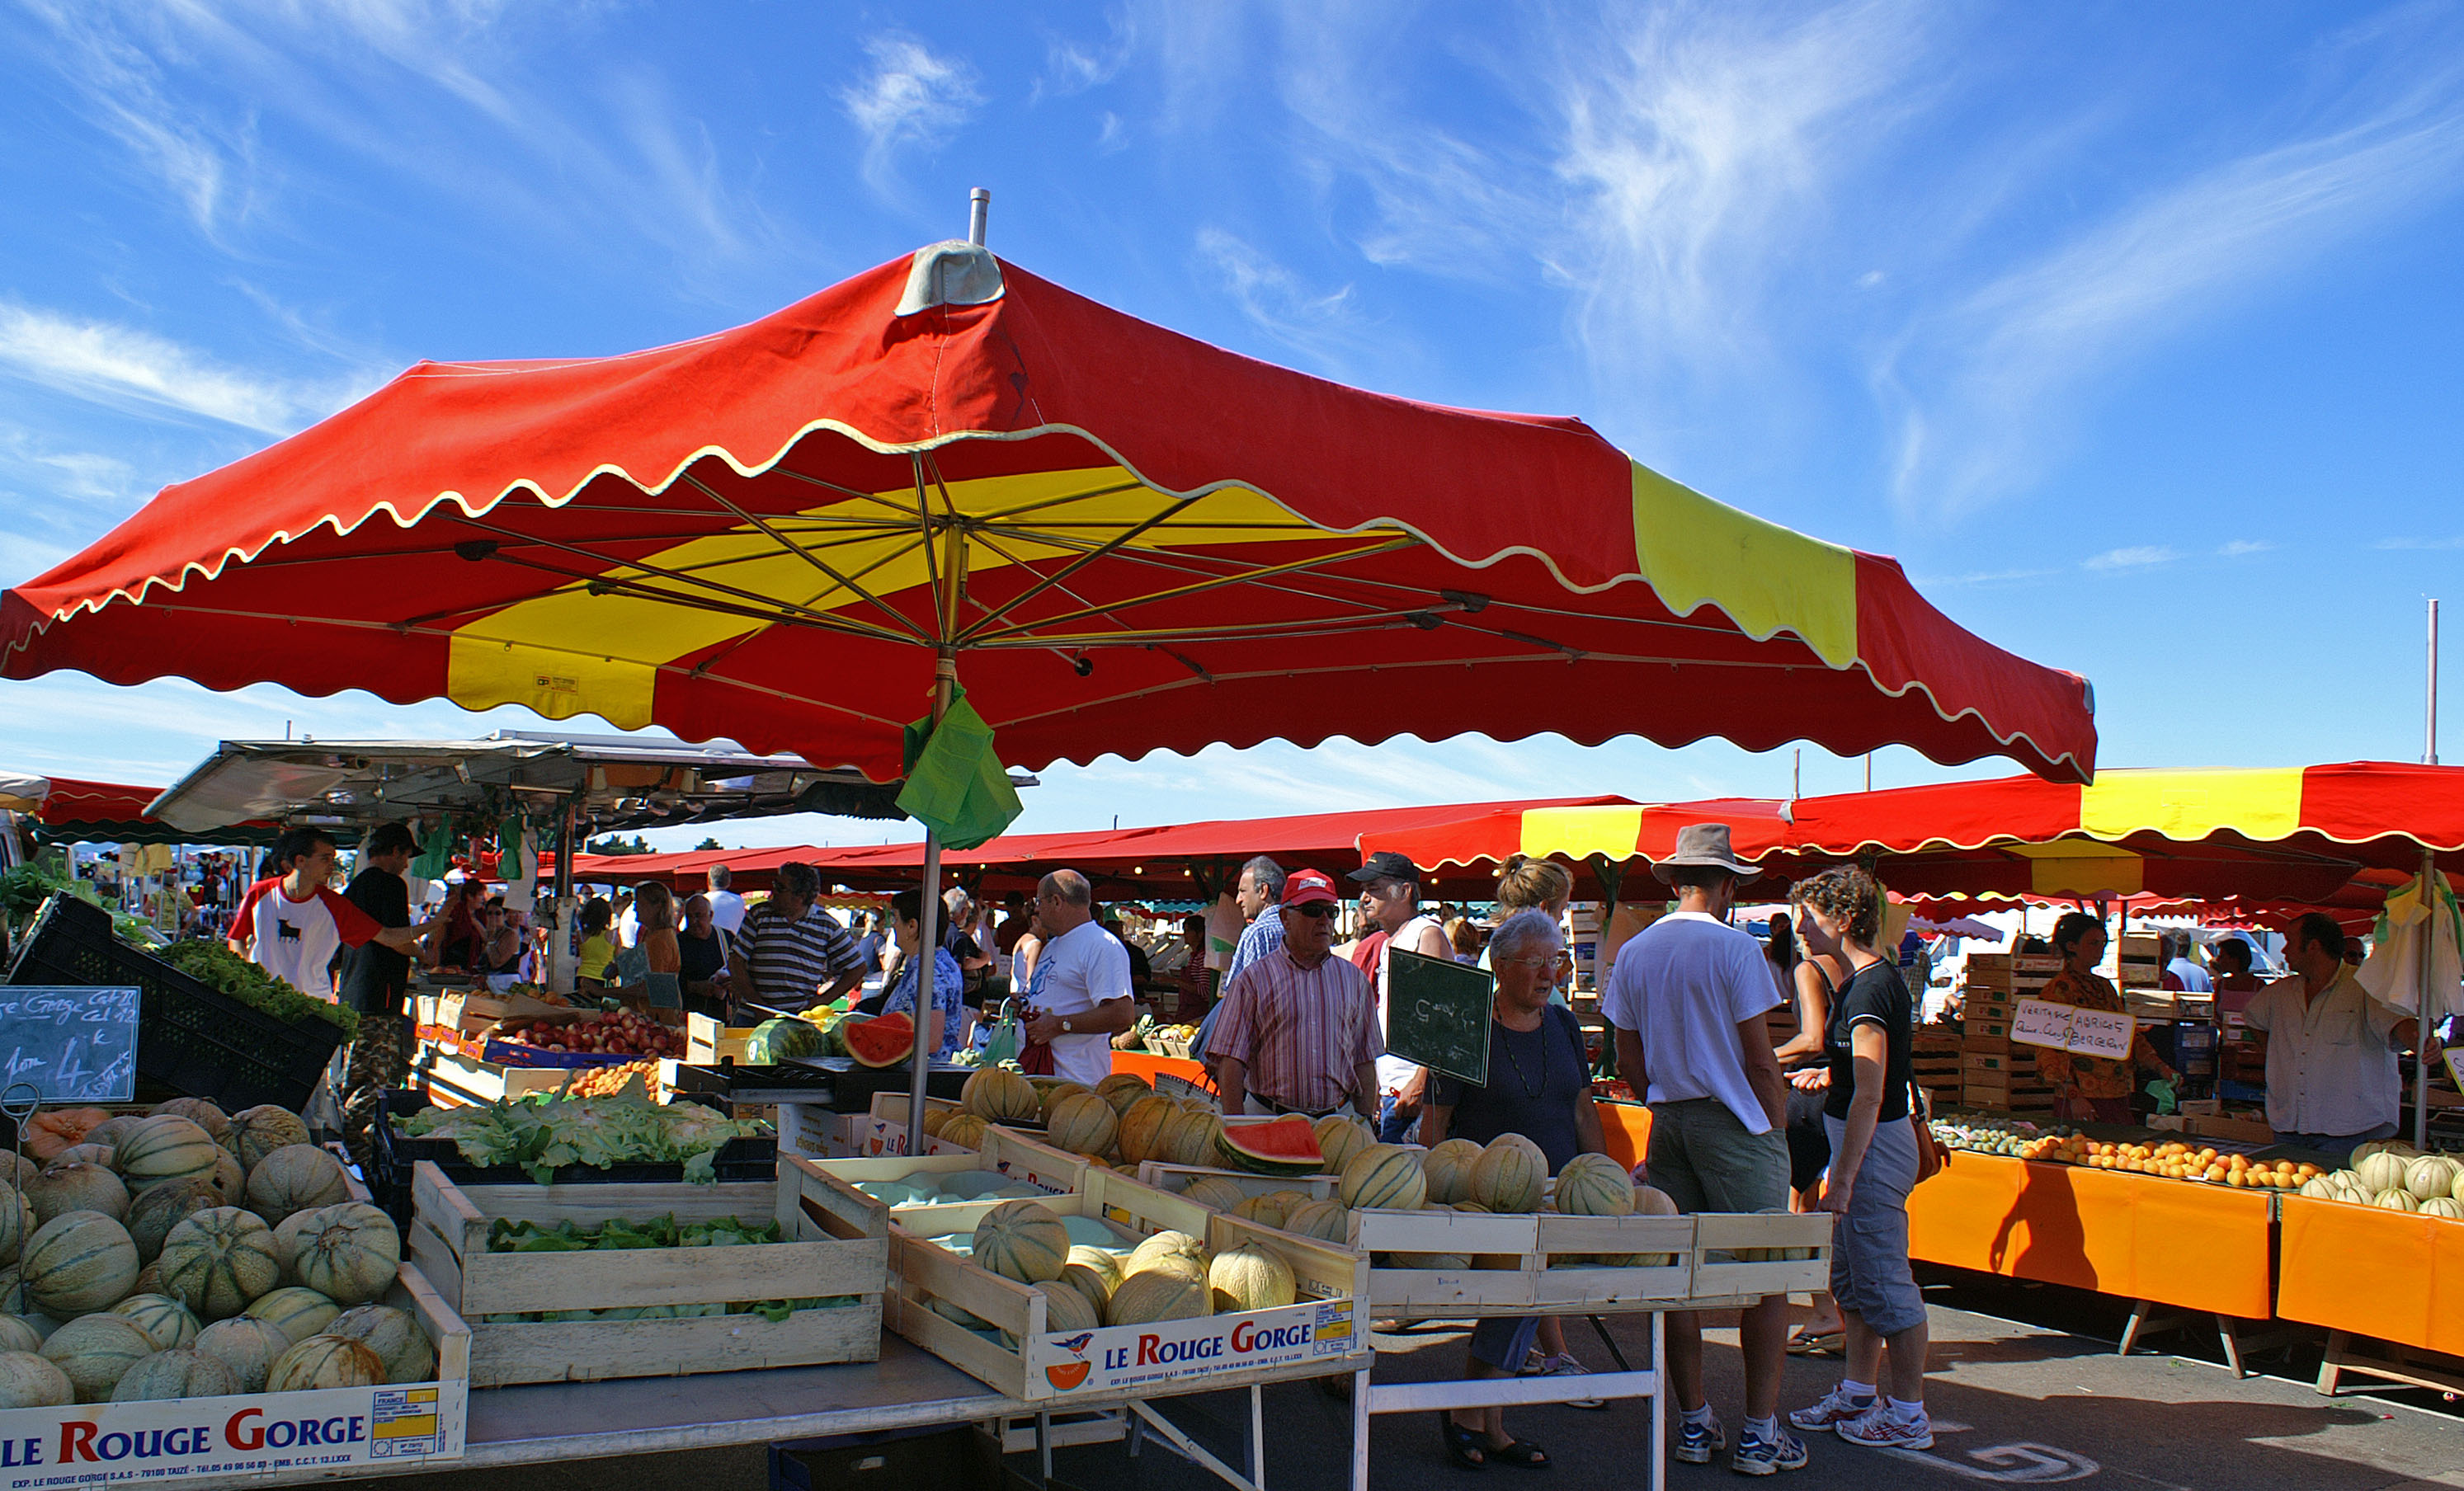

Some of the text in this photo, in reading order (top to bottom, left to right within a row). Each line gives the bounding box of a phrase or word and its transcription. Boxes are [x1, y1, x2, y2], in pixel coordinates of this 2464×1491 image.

[1105, 1347, 1129, 1371] LE
[1136, 1333, 1223, 1366] ROUGE
[1230, 1320, 1312, 1353] GORGE
[1, 1408, 366, 1468] LE ROUGE GORGE
[12, 1479, 31, 1489] EXP.
[34, 1479, 45, 1487] LE
[47, 1475, 77, 1485] ROUGE
[78, 1473, 107, 1483] GORGE
